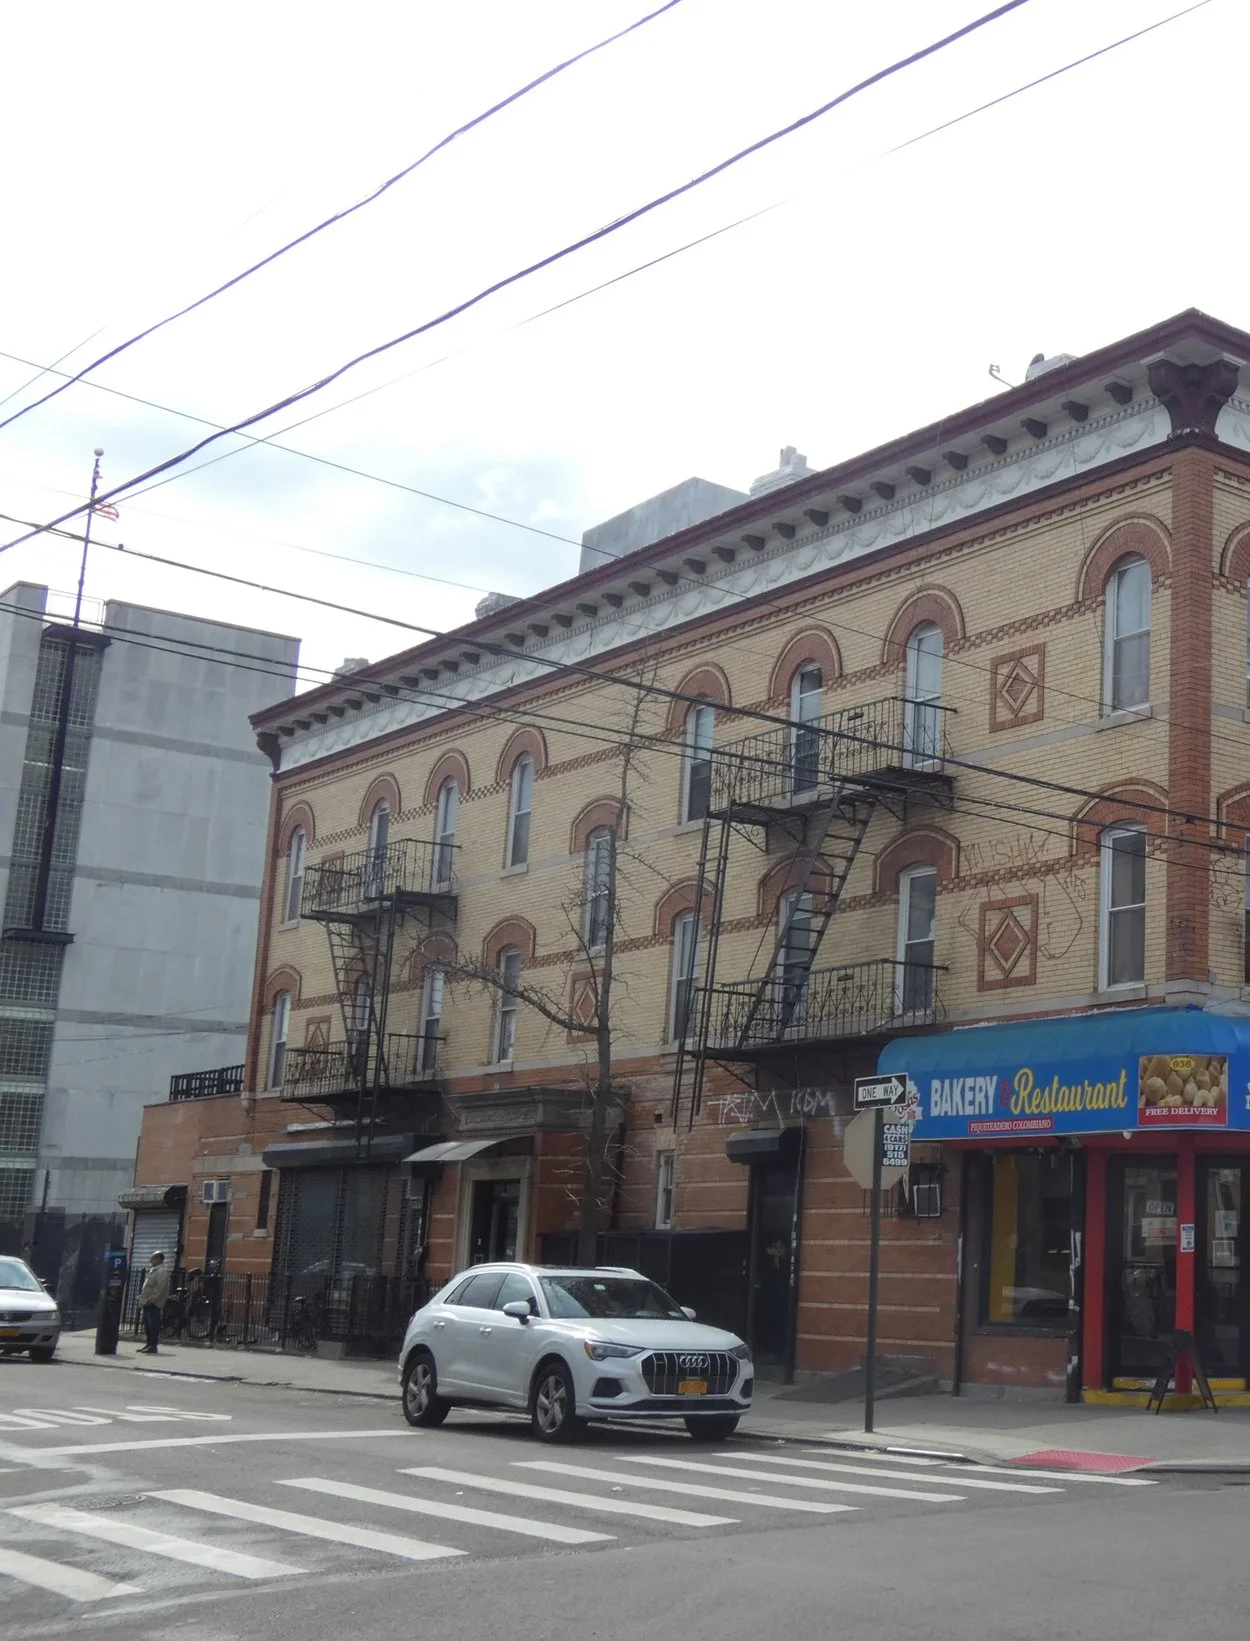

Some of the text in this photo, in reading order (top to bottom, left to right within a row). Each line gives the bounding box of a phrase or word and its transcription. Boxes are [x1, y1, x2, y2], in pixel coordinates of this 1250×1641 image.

[1172, 1060, 1192, 1069] 936
[861, 1083, 899, 1100] ONE WAY
[930, 1075, 998, 1117] BAKERY
[1010, 1068, 1128, 1115] Restaurant
[1145, 1107, 1219, 1116] FREE DELIVERY
[883, 1124, 908, 1135] CASH
[1012, 1118, 1052, 1131] COLOMBIANO
